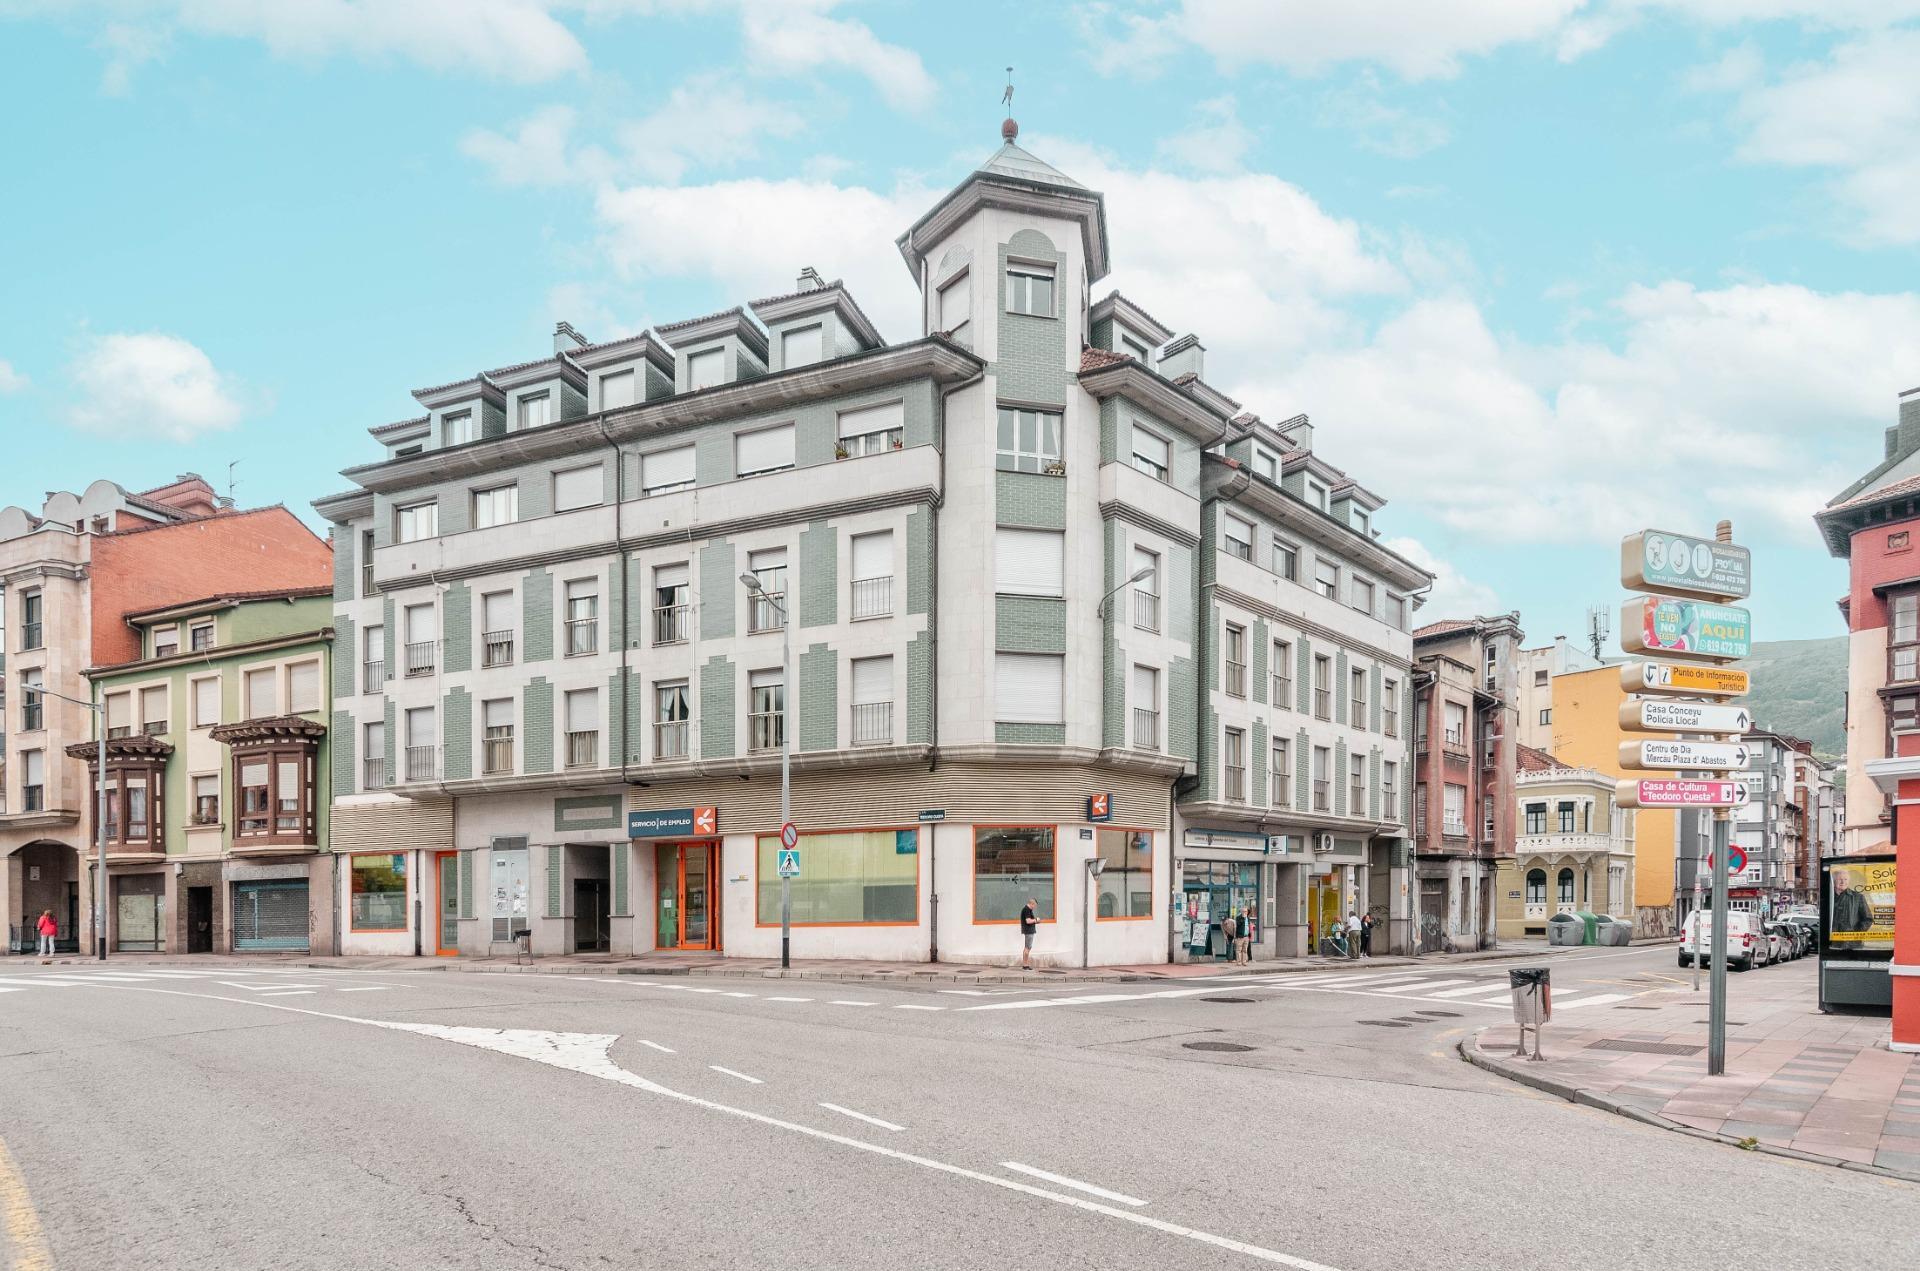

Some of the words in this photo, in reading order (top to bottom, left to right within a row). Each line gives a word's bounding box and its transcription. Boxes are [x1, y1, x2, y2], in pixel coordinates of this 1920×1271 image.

[1660, 623, 1676, 632] NO
[1673, 667, 1694, 678] Punto
[1695, 670, 1705, 679] de
[1646, 703, 1666, 713] Casa
[1668, 705, 1702, 717] Conceyu
[1675, 716, 1699, 726] Llocal
[1646, 744, 1669, 753] Centru
[1670, 745, 1679, 753] de
[1646, 754, 1671, 763] Mercau
[1673, 755, 1691, 764] Plaza
[1701, 756, 1727, 765] Abastos
[1642, 781, 1664, 790] Casa
[1666, 782, 1677, 791] de
[1678, 782, 1708, 791] Cultura
[631, 820, 656, 828] SERVICIO
[668, 818, 691, 826] EMPLEO
